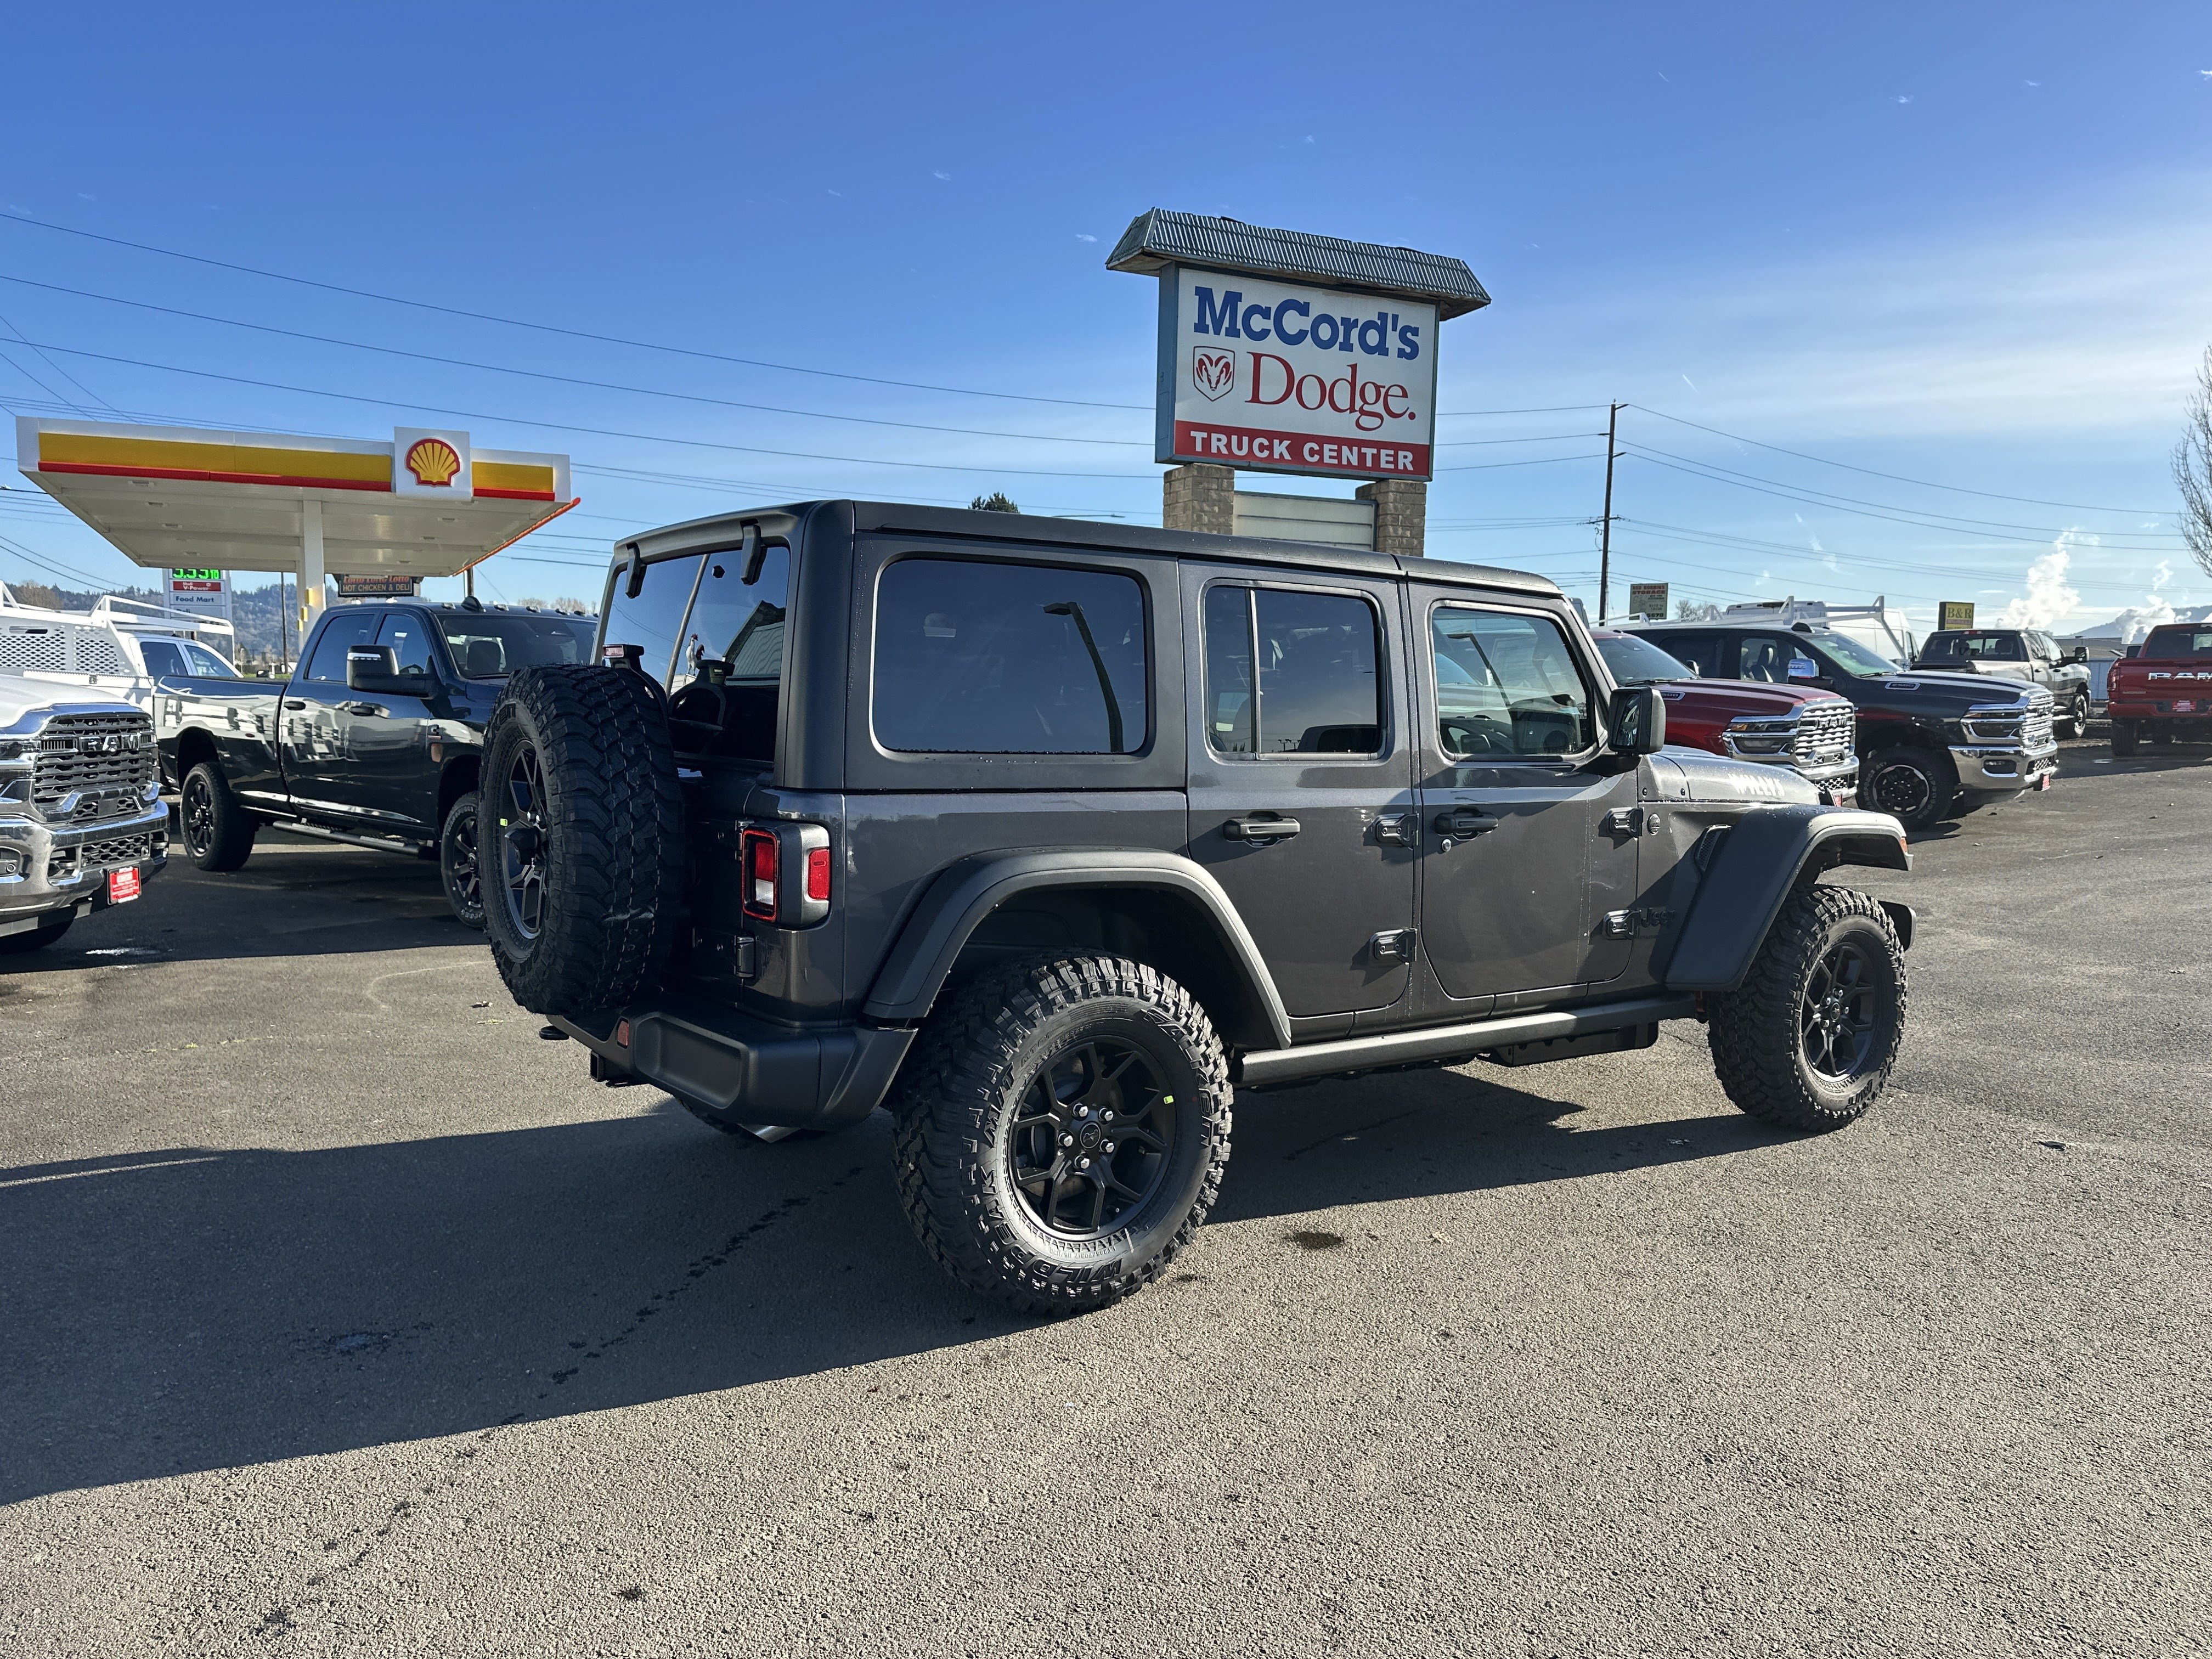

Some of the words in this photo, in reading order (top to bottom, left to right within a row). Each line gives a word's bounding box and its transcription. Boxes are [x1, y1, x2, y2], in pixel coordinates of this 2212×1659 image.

[1194, 286, 1420, 360] McCord's
[1190, 430, 1292, 461] TRUCK
[1303, 442, 1414, 471] CENTER
[1947, 607, 1972, 619] B&R
[2148, 672, 2212, 680] RAM
[1818, 716, 1847, 729] RAM
[79, 735, 140, 752] RAM
